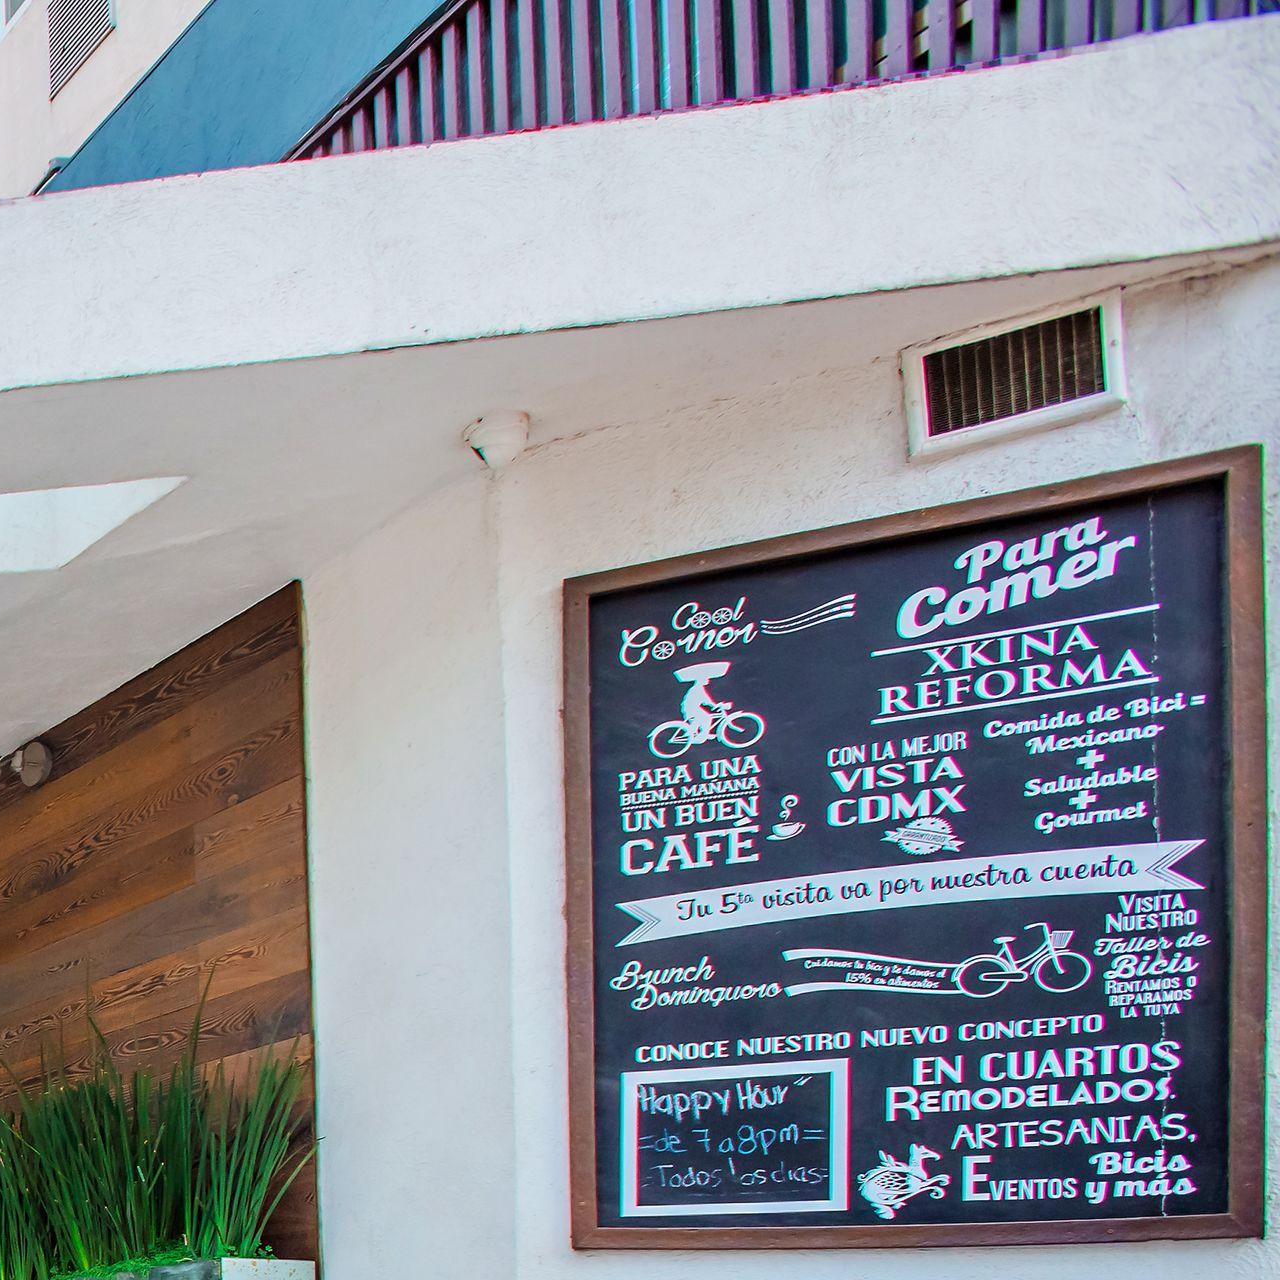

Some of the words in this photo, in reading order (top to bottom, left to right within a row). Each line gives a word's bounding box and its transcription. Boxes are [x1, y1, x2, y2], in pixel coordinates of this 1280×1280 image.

[954, 516, 1108, 584] Para
[896, 535, 1138, 639] Comer
[672, 596, 747, 630] Cool
[619, 622, 762, 668] Corner
[921, 625, 1099, 677] XKINA
[877, 649, 1154, 716] REFORMA
[983, 703, 1084, 739] Comida
[1086, 701, 1121, 724] de
[1123, 691, 1186, 719] Bici
[826, 747, 866, 768] CON
[871, 740, 897, 761] LA
[900, 731, 969, 757] MEJOR
[1025, 724, 1165, 756] Mexicano
[618, 764, 691, 791] PARA
[700, 755, 762, 781] UNA
[830, 756, 965, 793] VISTA
[1023, 766, 1159, 798] Saludable
[619, 788, 676, 807] BUENA
[681, 776, 760, 798] MAÑANA
[826, 785, 967, 827] CDMX
[621, 807, 666, 833] UN
[675, 796, 760, 828] BUEN
[1034, 801, 1148, 834] Gourmet
[620, 816, 761, 876] CAFÉ
[676, 899, 713, 921] Tu
[762, 882, 834, 909] visita
[840, 881, 871, 900] va
[879, 877, 924, 902] por
[931, 864, 1033, 891] nuestra
[1040, 855, 1139, 883] cuenta
[1117, 893, 1187, 915] VISITA
[1105, 909, 1198, 933] NUESTRO
[1094, 936, 1173, 956] Taller
[1174, 931, 1211, 948] de
[609, 955, 716, 990] Brunch
[845, 972, 872, 983] 15%
[1103, 952, 1200, 980] Bicis
[630, 981, 783, 1011] Dominguero
[1104, 977, 1180, 995] RENTAMOS
[1186, 975, 1197, 987] O
[1109, 989, 1192, 1007] REPARAMOS
[1119, 1006, 1138, 1019] LA
[1143, 1003, 1180, 1017] TUYA
[635, 1040, 729, 1063] CONOCE
[737, 1031, 853, 1057] NUESTRO
[860, 1025, 948, 1048] NUEVO
[958, 1014, 1106, 1042] CONCEPTO
[912, 1055, 964, 1086] EN
[979, 1040, 1183, 1082] CUARTOS
[691, 1128, 711, 1152] 7
[950, 1113, 1197, 1150] ARTESANIAS,
[961, 1155, 1078, 1202] EVENTOS
[1084, 1182, 1108, 1205] y
[1113, 1173, 1197, 1197] más
[1088, 1150, 1193, 1176] Bicis
